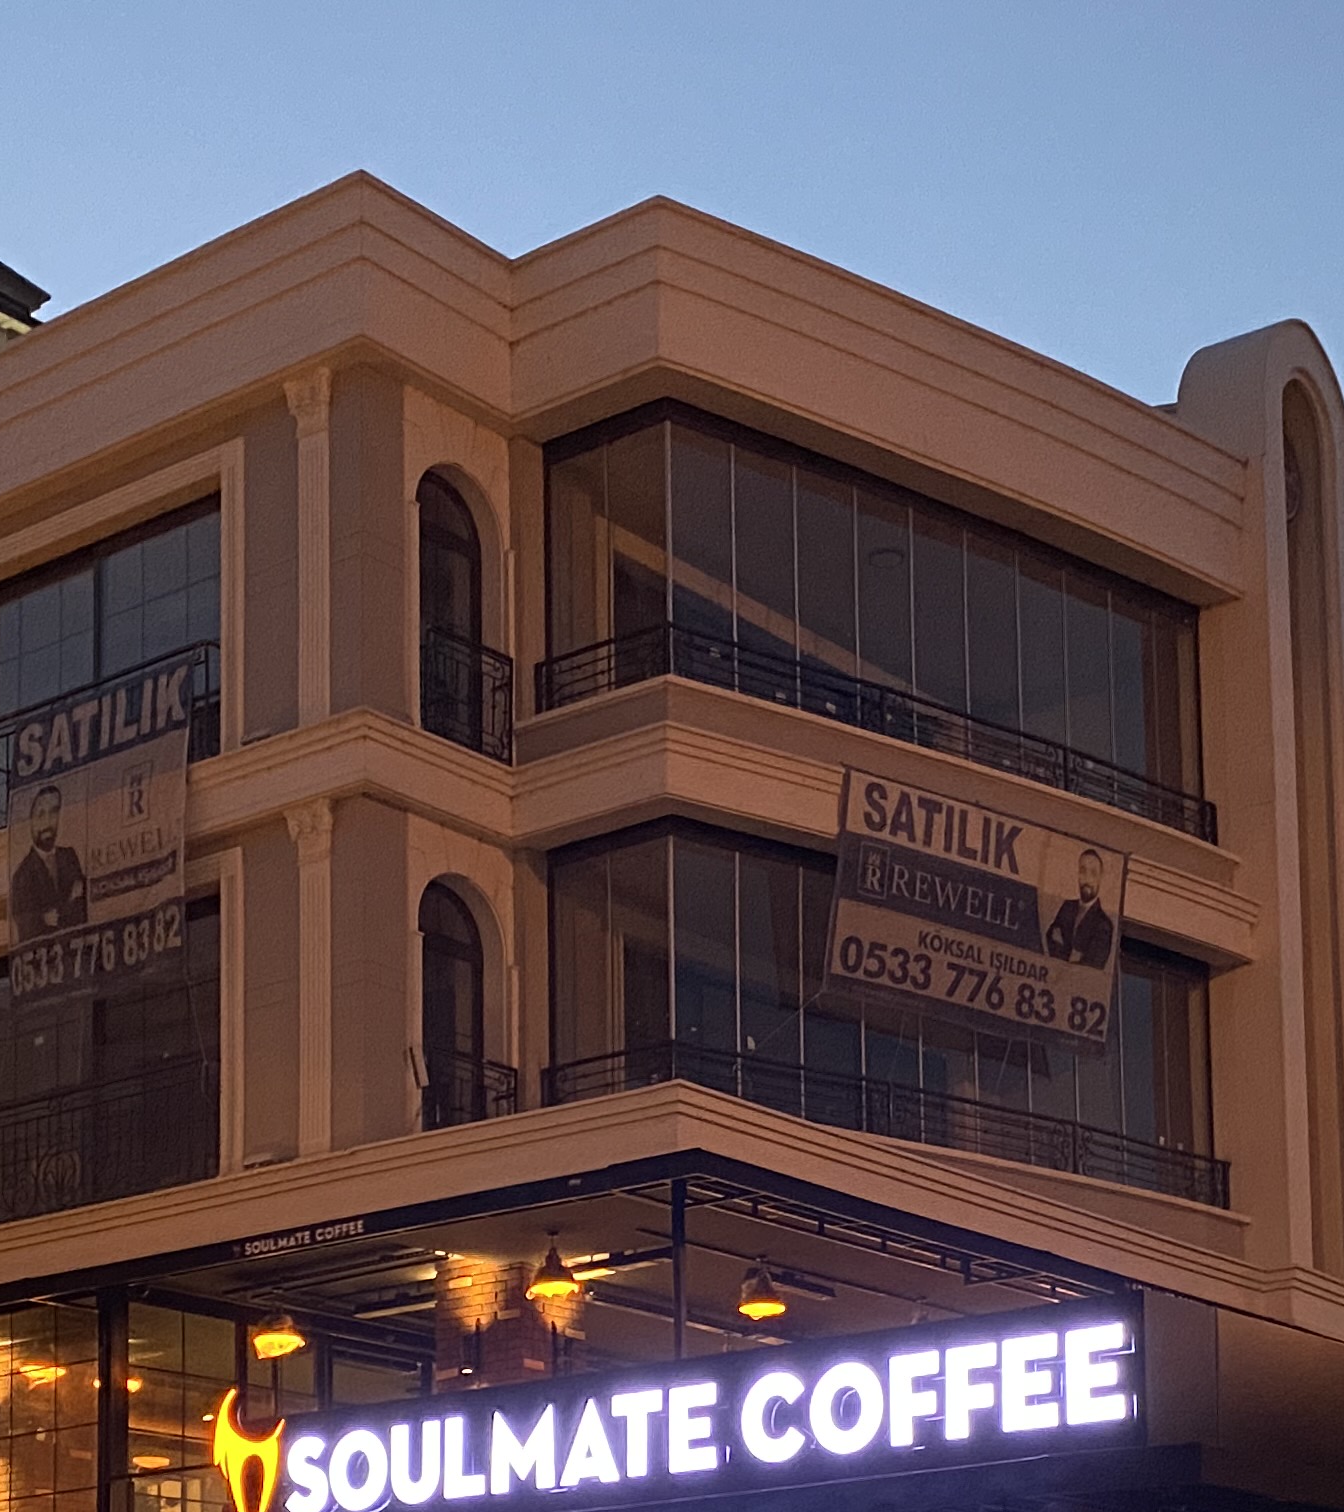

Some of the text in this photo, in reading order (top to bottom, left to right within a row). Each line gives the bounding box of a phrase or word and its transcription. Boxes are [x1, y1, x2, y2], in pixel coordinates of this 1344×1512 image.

[17, 665, 187, 777] SATILIK
[863, 782, 1025, 875] SATILIK
[890, 865, 1021, 931] REWELL
[11, 905, 182, 996] 0533 776 83 82
[839, 935, 1107, 1036] 0533 776 83 82
[917, 930, 1050, 983] KÖKSAL IŞILDAR
[244, 1220, 364, 1256] SOULMATE COFFEE
[739, 1320, 1129, 1464] COFFEE
